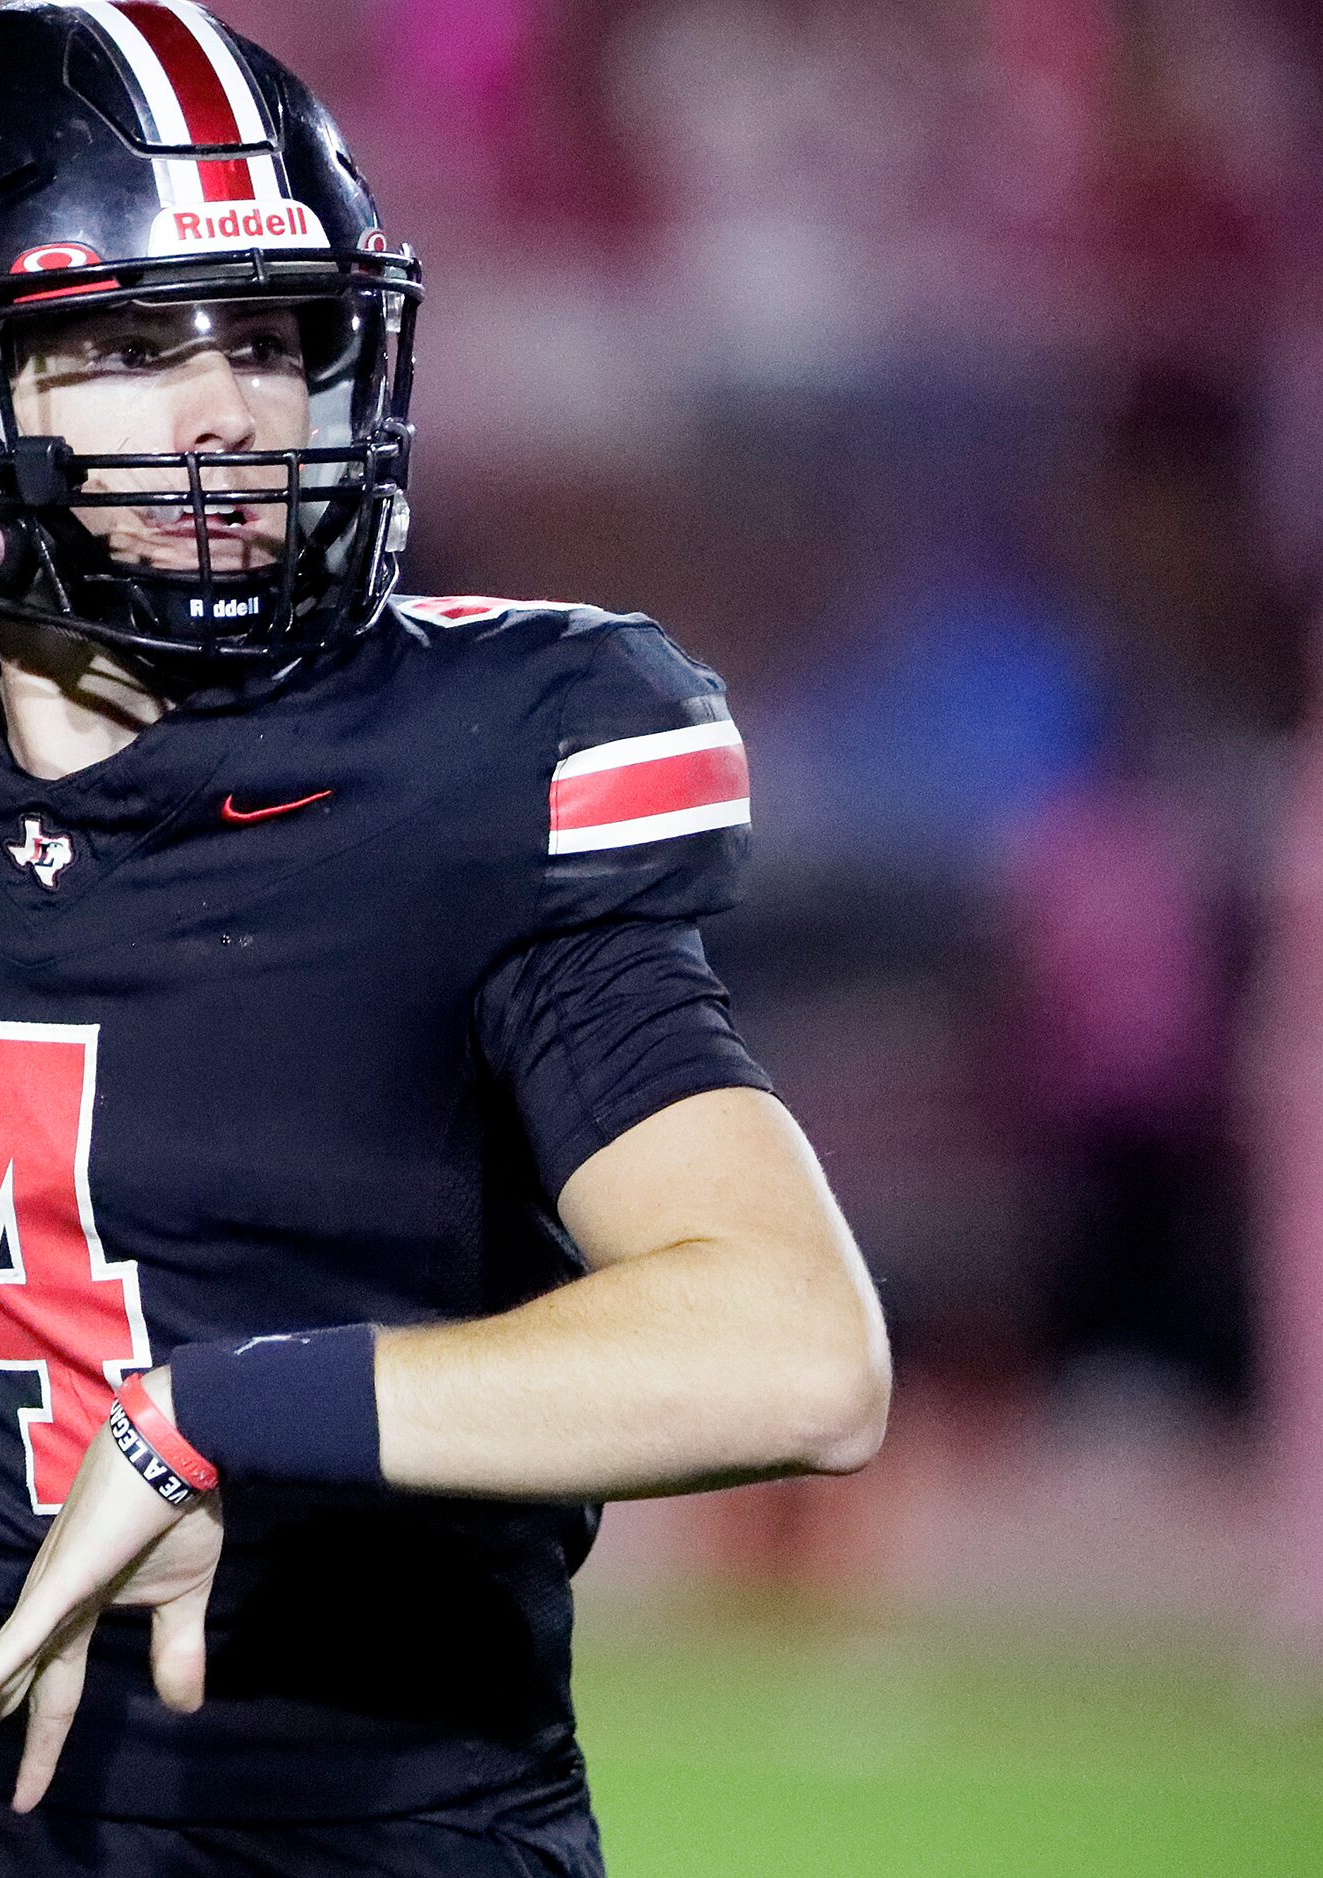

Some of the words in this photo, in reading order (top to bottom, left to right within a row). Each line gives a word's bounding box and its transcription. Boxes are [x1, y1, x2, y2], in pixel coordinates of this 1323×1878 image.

[173, 207, 308, 241] Riddell
[189, 596, 259, 618] Rddell
[142, 1456, 169, 1481] A
